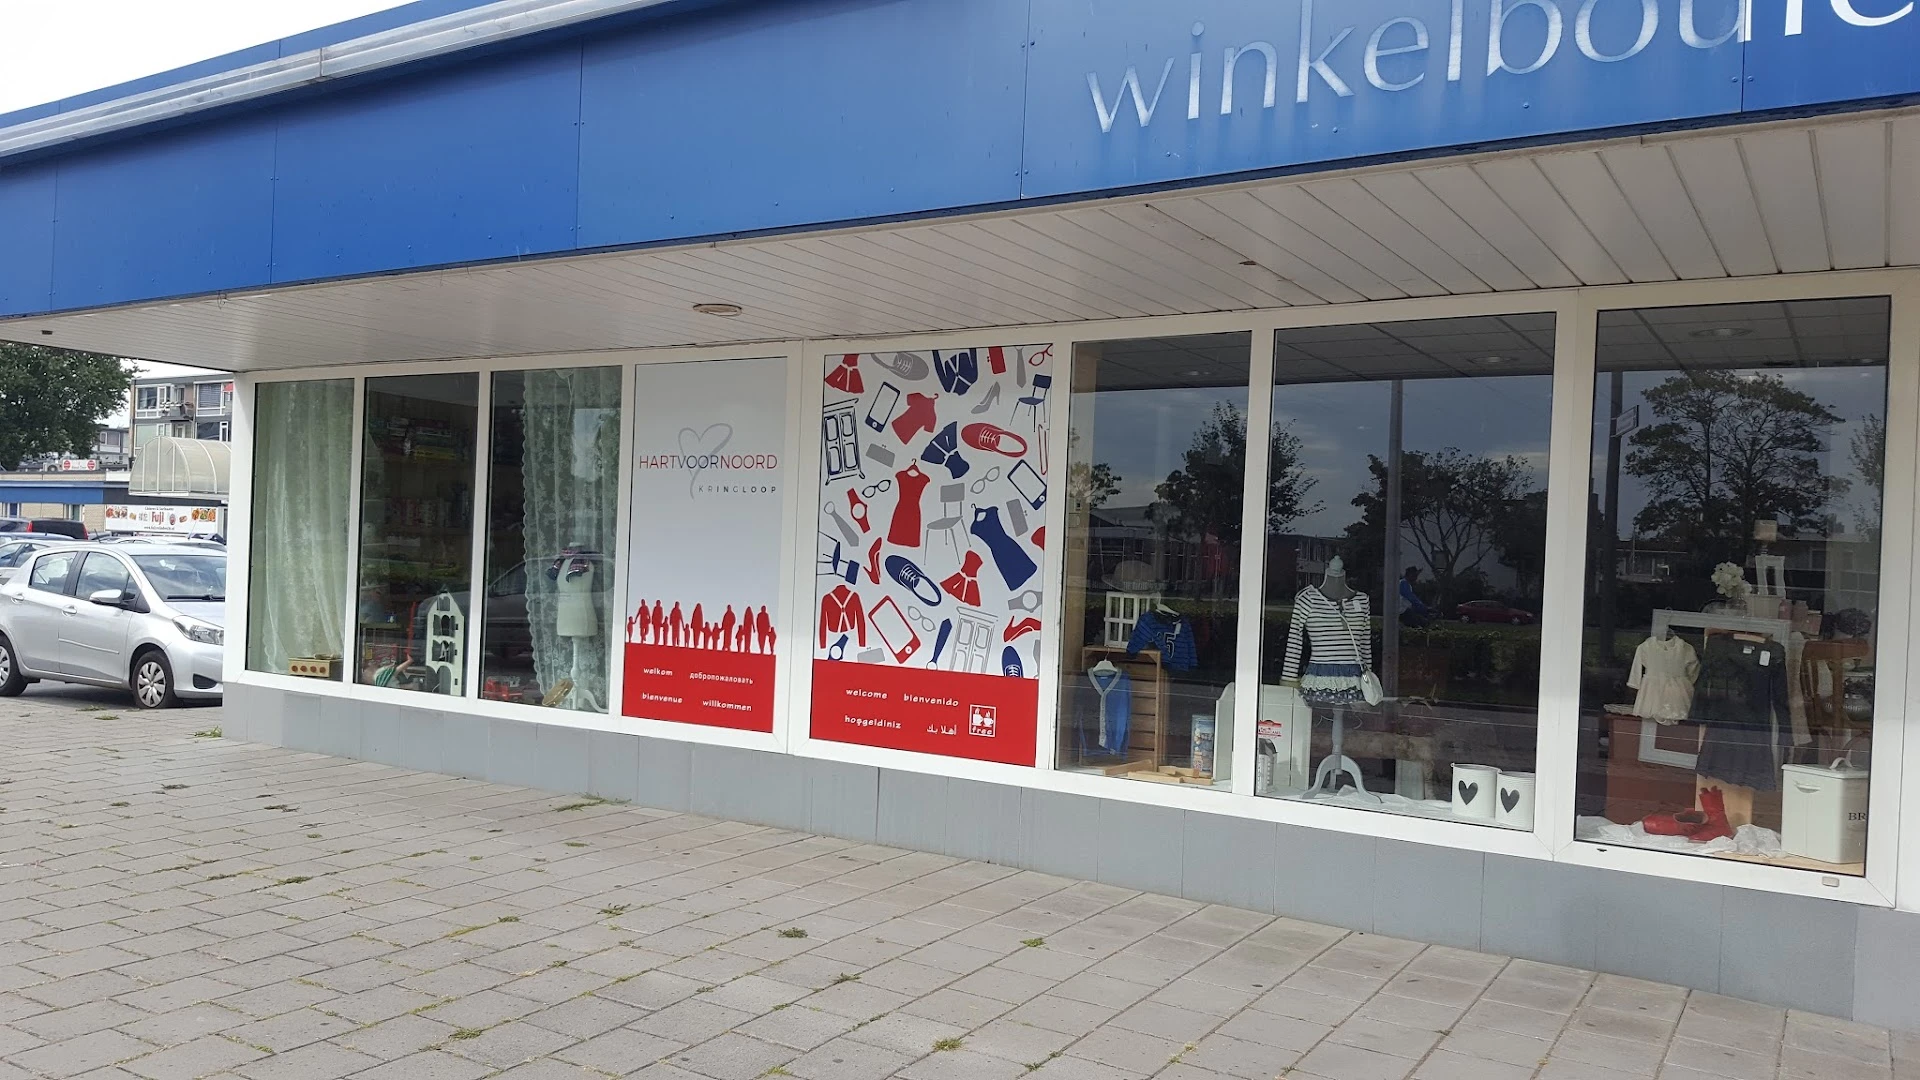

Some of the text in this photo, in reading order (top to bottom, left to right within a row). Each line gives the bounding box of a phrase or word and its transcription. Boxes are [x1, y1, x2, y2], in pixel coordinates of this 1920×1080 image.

[1086, 0, 1914, 133] winkelbou
[639, 454, 778, 469] HARTVOORNOORD
[699, 485, 777, 494] KRINGLOOP
[151, 511, 164, 525] Fuji
[643, 667, 673, 676] welkom
[690, 672, 753, 684] добропожаловать
[642, 692, 683, 704] bienvenue
[846, 689, 887, 699] welcome
[903, 694, 959, 706] bienvenido
[703, 700, 752, 711] willkommen
[972, 726, 992, 735] free
